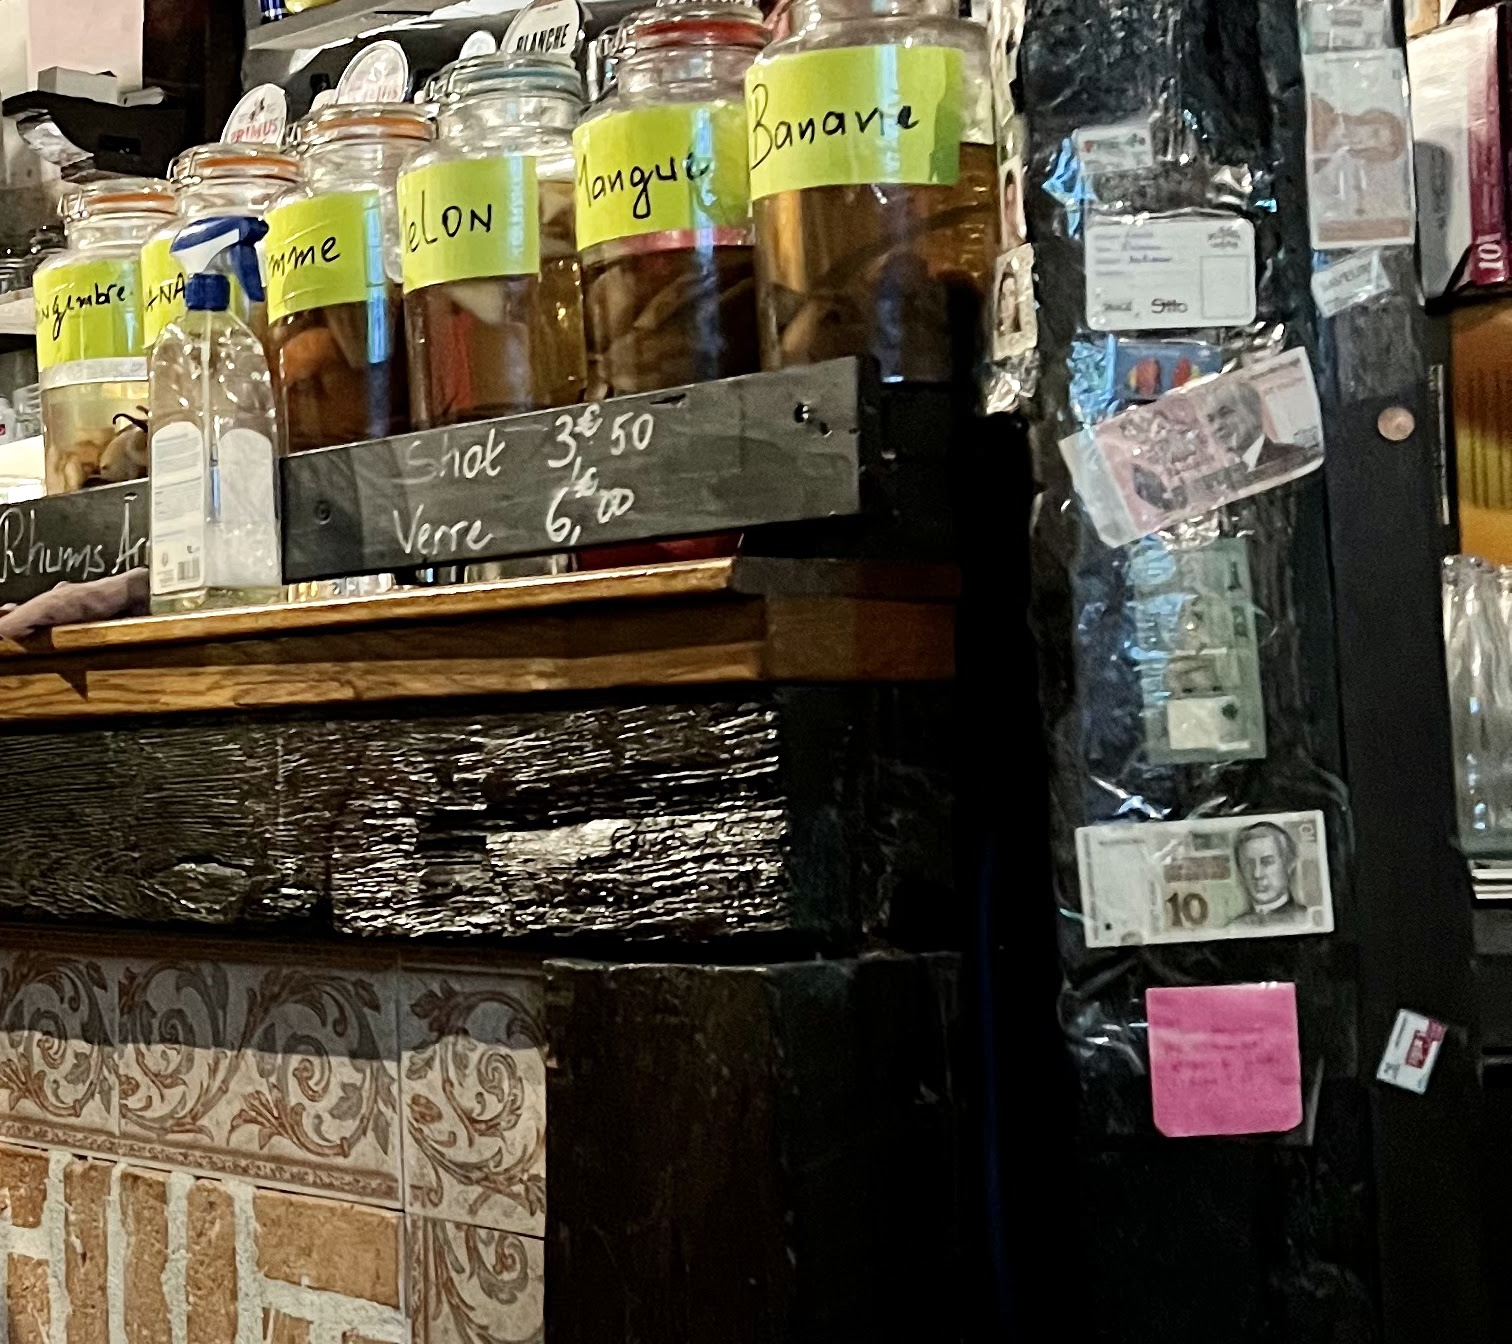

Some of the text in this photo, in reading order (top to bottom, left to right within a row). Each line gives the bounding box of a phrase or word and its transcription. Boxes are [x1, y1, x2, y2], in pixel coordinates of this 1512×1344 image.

[749, 83, 920, 170] Banane
[391, 428, 506, 483] Shot
[393, 504, 493, 554] Verre
[1165, 893, 1208, 928] 10
